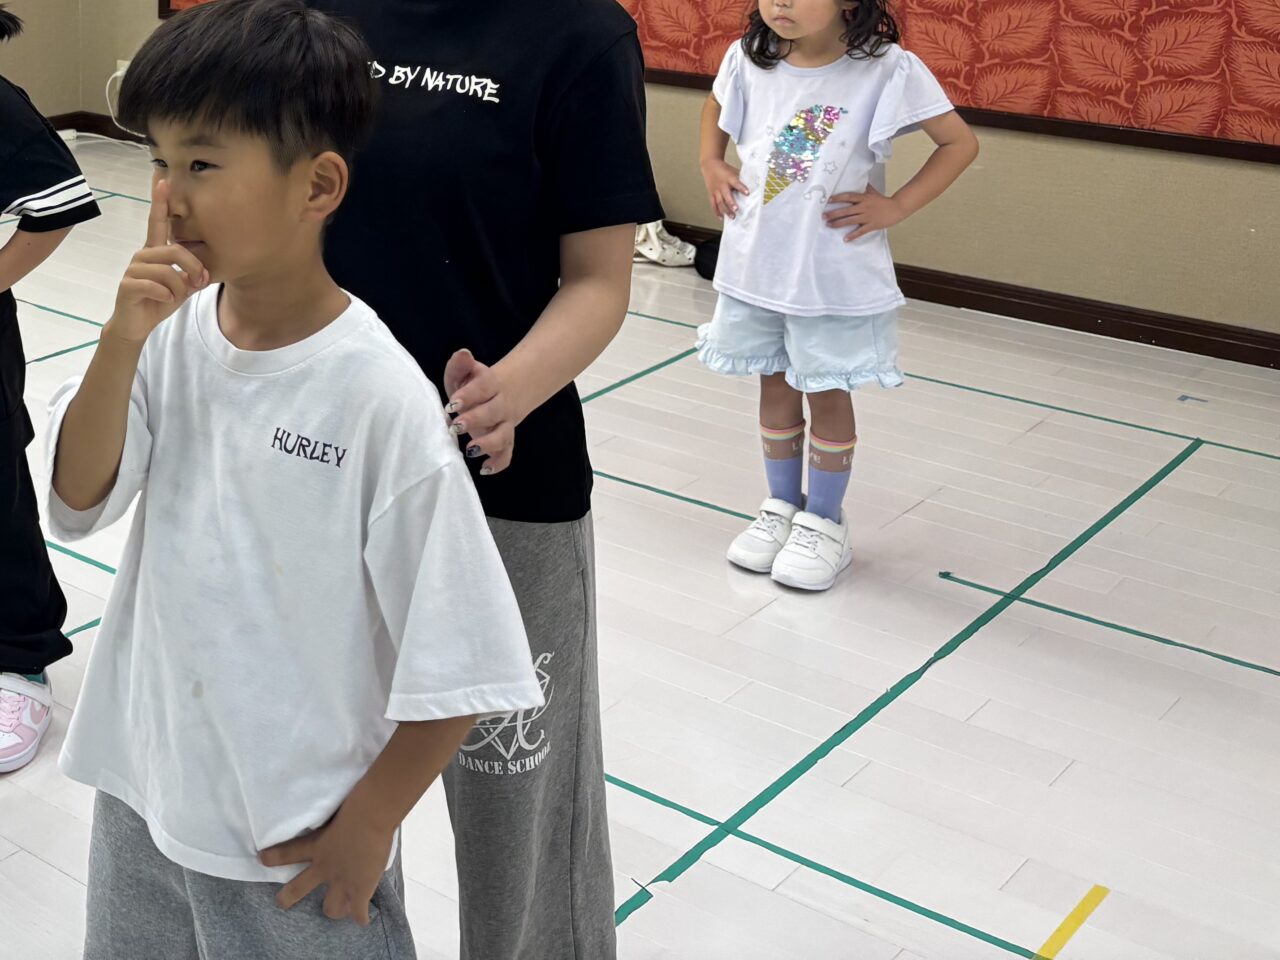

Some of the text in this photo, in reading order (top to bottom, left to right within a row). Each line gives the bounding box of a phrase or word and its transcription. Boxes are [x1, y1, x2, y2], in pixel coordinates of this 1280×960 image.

[388, 65, 421, 89] BY
[421, 67, 500, 103] NATURE
[271, 427, 348, 468] HURLEY
[458, 741, 552, 775] DANCE SCHOOL
